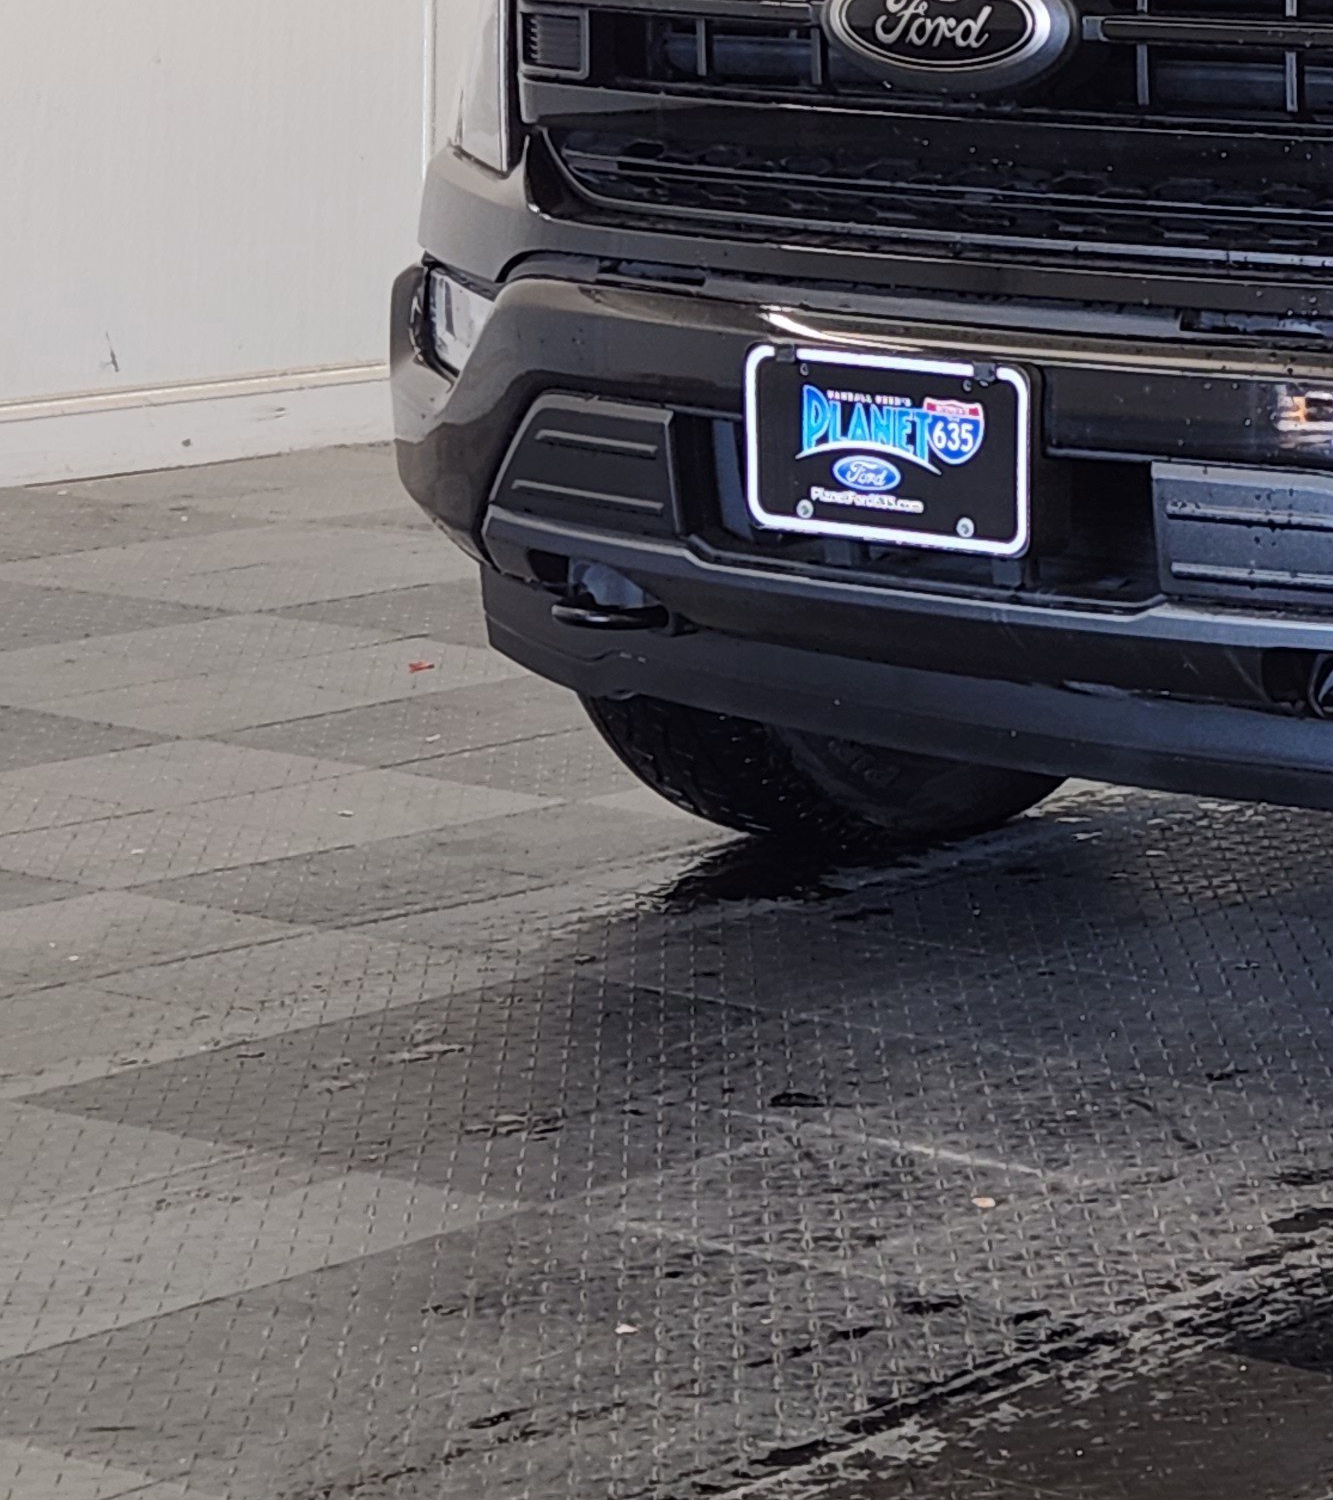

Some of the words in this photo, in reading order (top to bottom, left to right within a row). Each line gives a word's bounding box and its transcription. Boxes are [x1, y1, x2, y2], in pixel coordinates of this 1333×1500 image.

[803, 384, 932, 463] PLANET
[933, 420, 974, 452] 635
[846, 461, 887, 486] Ford
